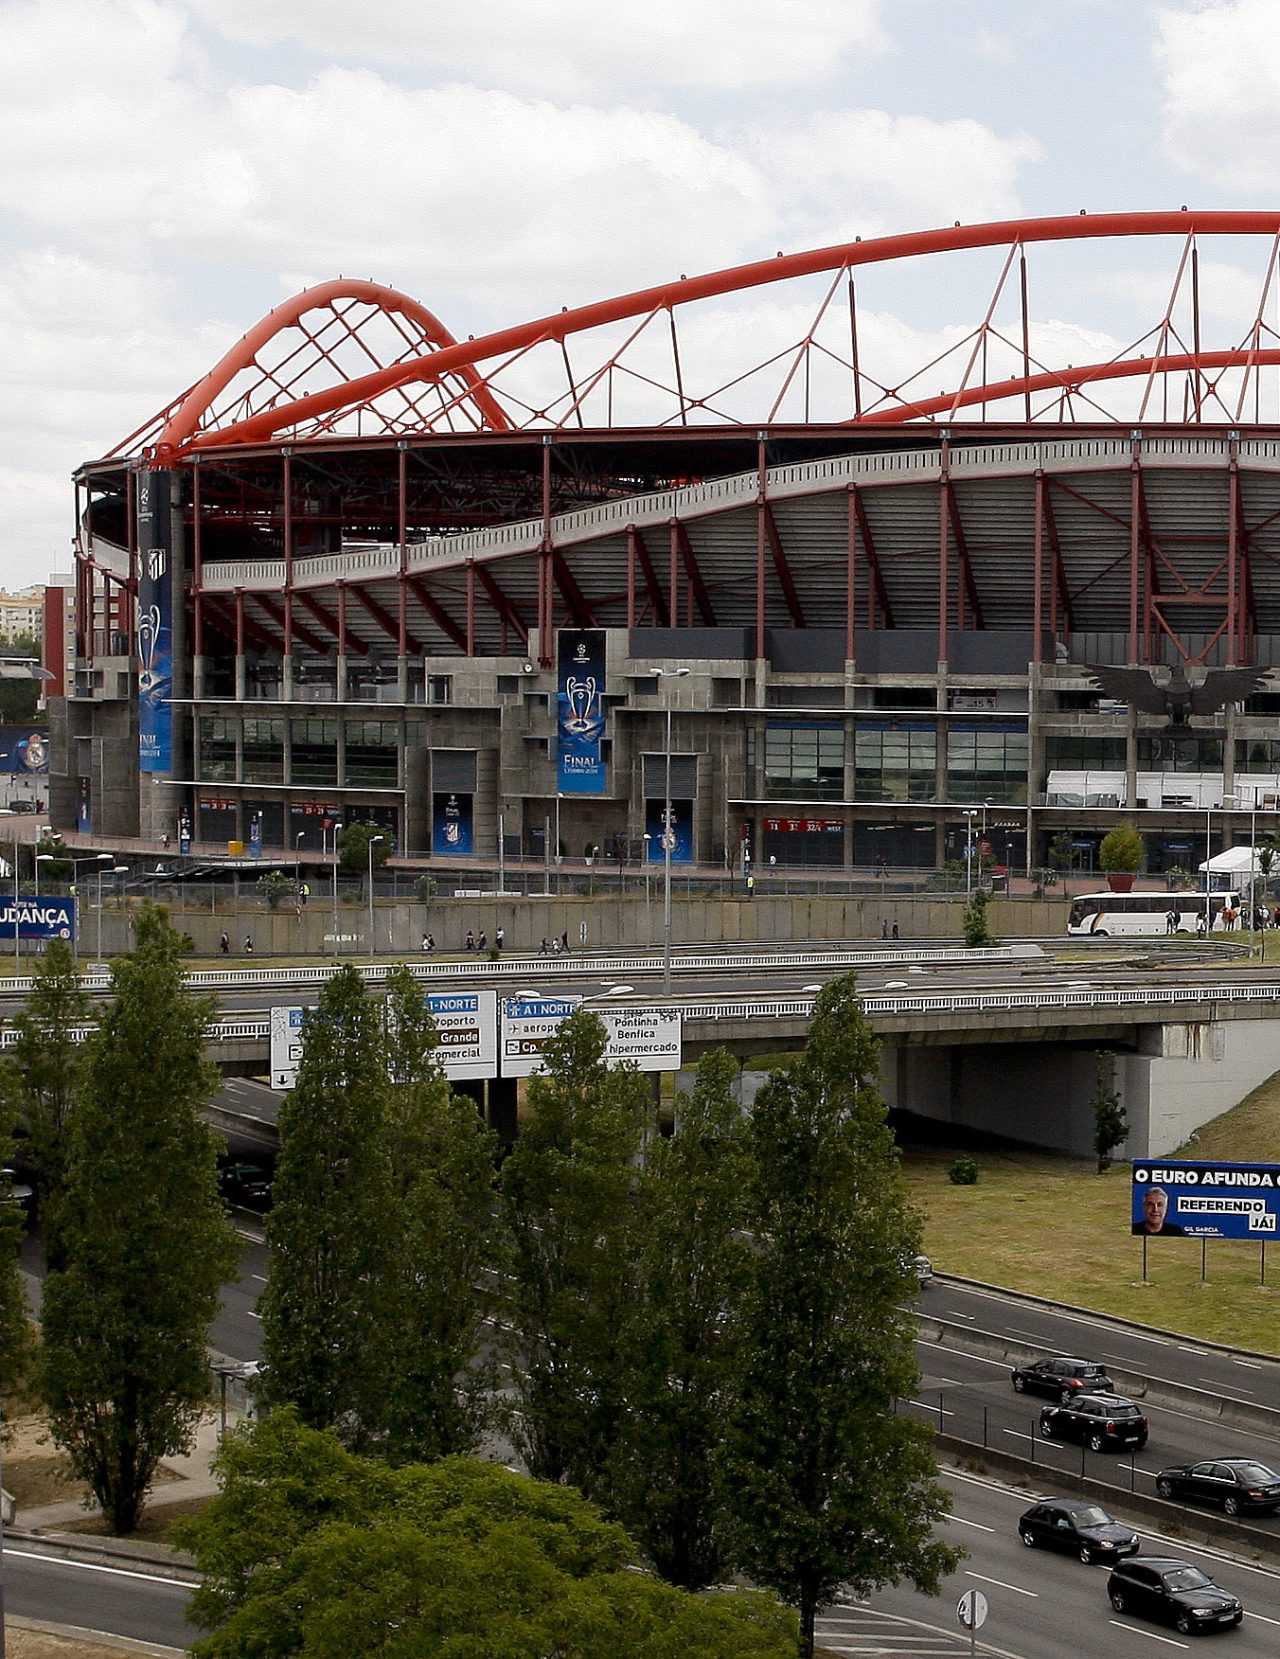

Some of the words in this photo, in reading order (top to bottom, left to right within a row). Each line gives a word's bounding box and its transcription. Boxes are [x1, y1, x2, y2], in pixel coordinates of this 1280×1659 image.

[139, 734, 160, 749] INAL
[564, 754, 598, 768] FINAL
[0, 908, 69, 928] UDANÇA
[430, 999, 477, 1011] 1-NORTE
[436, 1016, 476, 1027] roporto
[614, 1017, 658, 1028] Pontinha
[441, 1032, 478, 1043] Grande
[617, 1029, 656, 1039] Benfica
[609, 1042, 678, 1055] hipermercado
[1135, 1169, 1149, 1183] O
[1151, 1169, 1198, 1185] EURO
[1201, 1171, 1274, 1188] AFUNDA
[1180, 1199, 1263, 1212] REFERENDO
